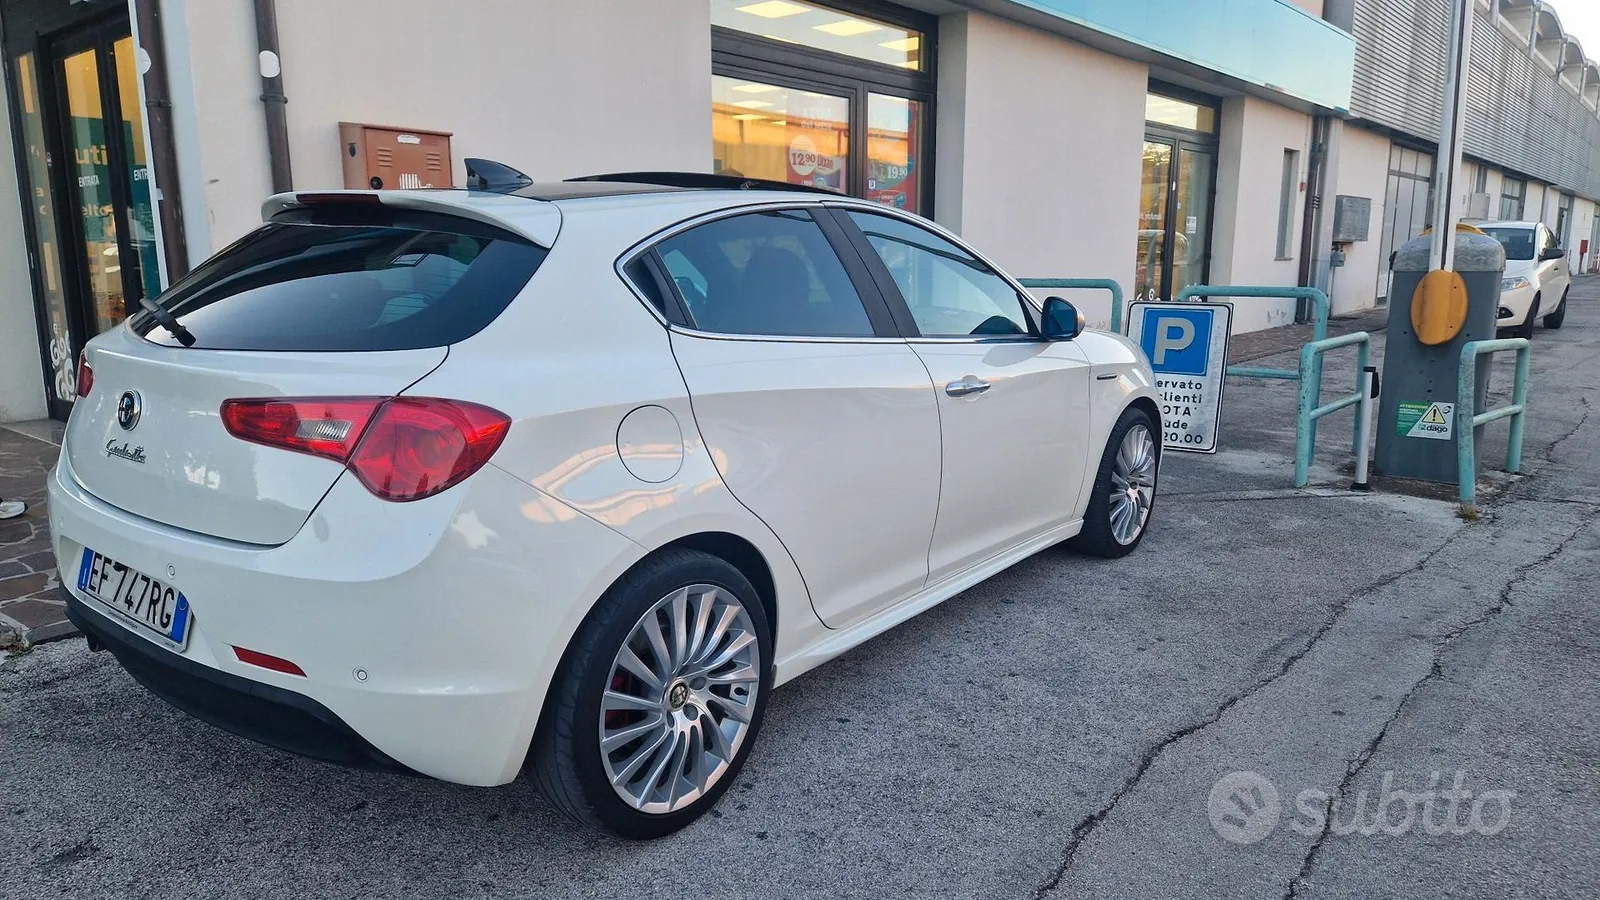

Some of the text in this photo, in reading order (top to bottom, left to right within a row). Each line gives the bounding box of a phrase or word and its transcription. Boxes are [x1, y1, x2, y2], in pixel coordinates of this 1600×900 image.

[75, 145, 108, 165] uti
[133, 168, 148, 181] ENTR
[78, 175, 100, 187] ENTRATA
[1153, 317, 1195, 365] P
[1157, 379, 1203, 390] ervato
[1163, 405, 1198, 417] OTA'
[1164, 419, 1188, 430] ude
